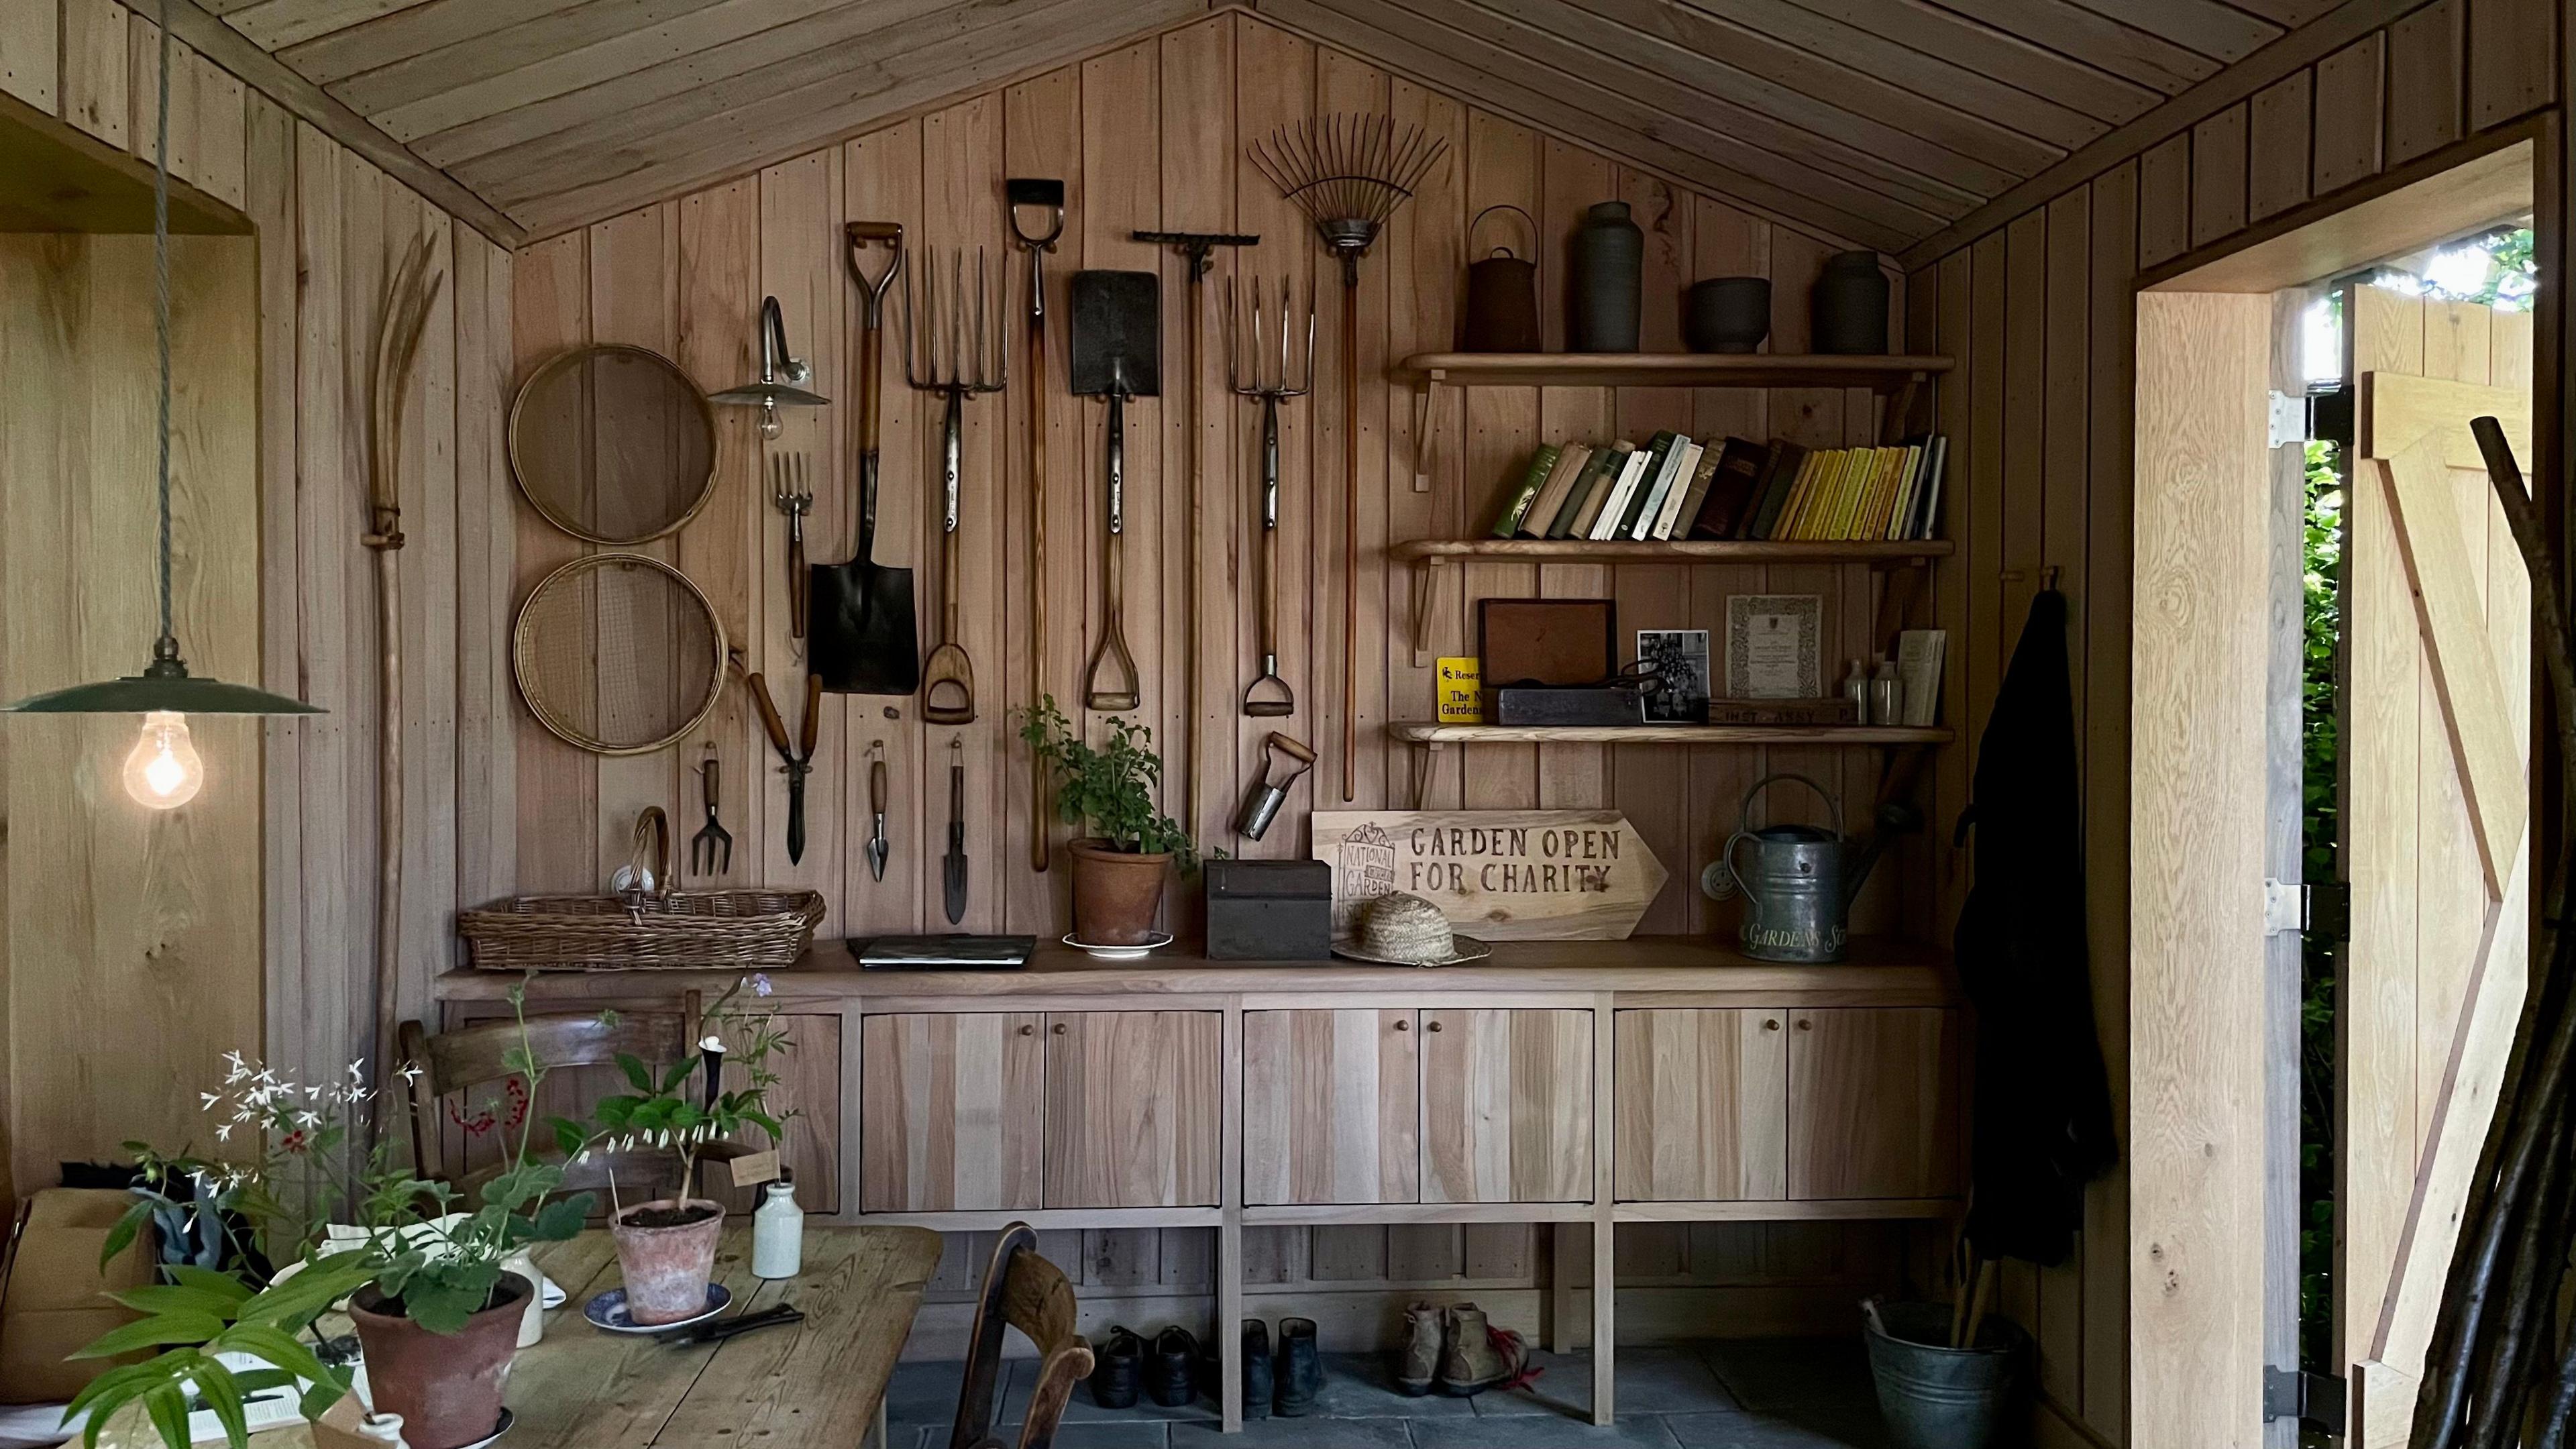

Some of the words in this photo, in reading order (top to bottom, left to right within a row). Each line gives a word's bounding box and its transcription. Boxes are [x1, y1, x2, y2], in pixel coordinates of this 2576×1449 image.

[1451, 690, 1470, 702] The
[1346, 846, 1391, 867] NATIONAL
[1411, 828, 1528, 856] GARDEN
[1542, 828, 1621, 859] OPEN
[1346, 870, 1391, 897] GARDEN
[1410, 861, 1464, 892] FOR
[1481, 863, 1611, 893] CHARITY
[1750, 923, 1821, 950] GARDENS
